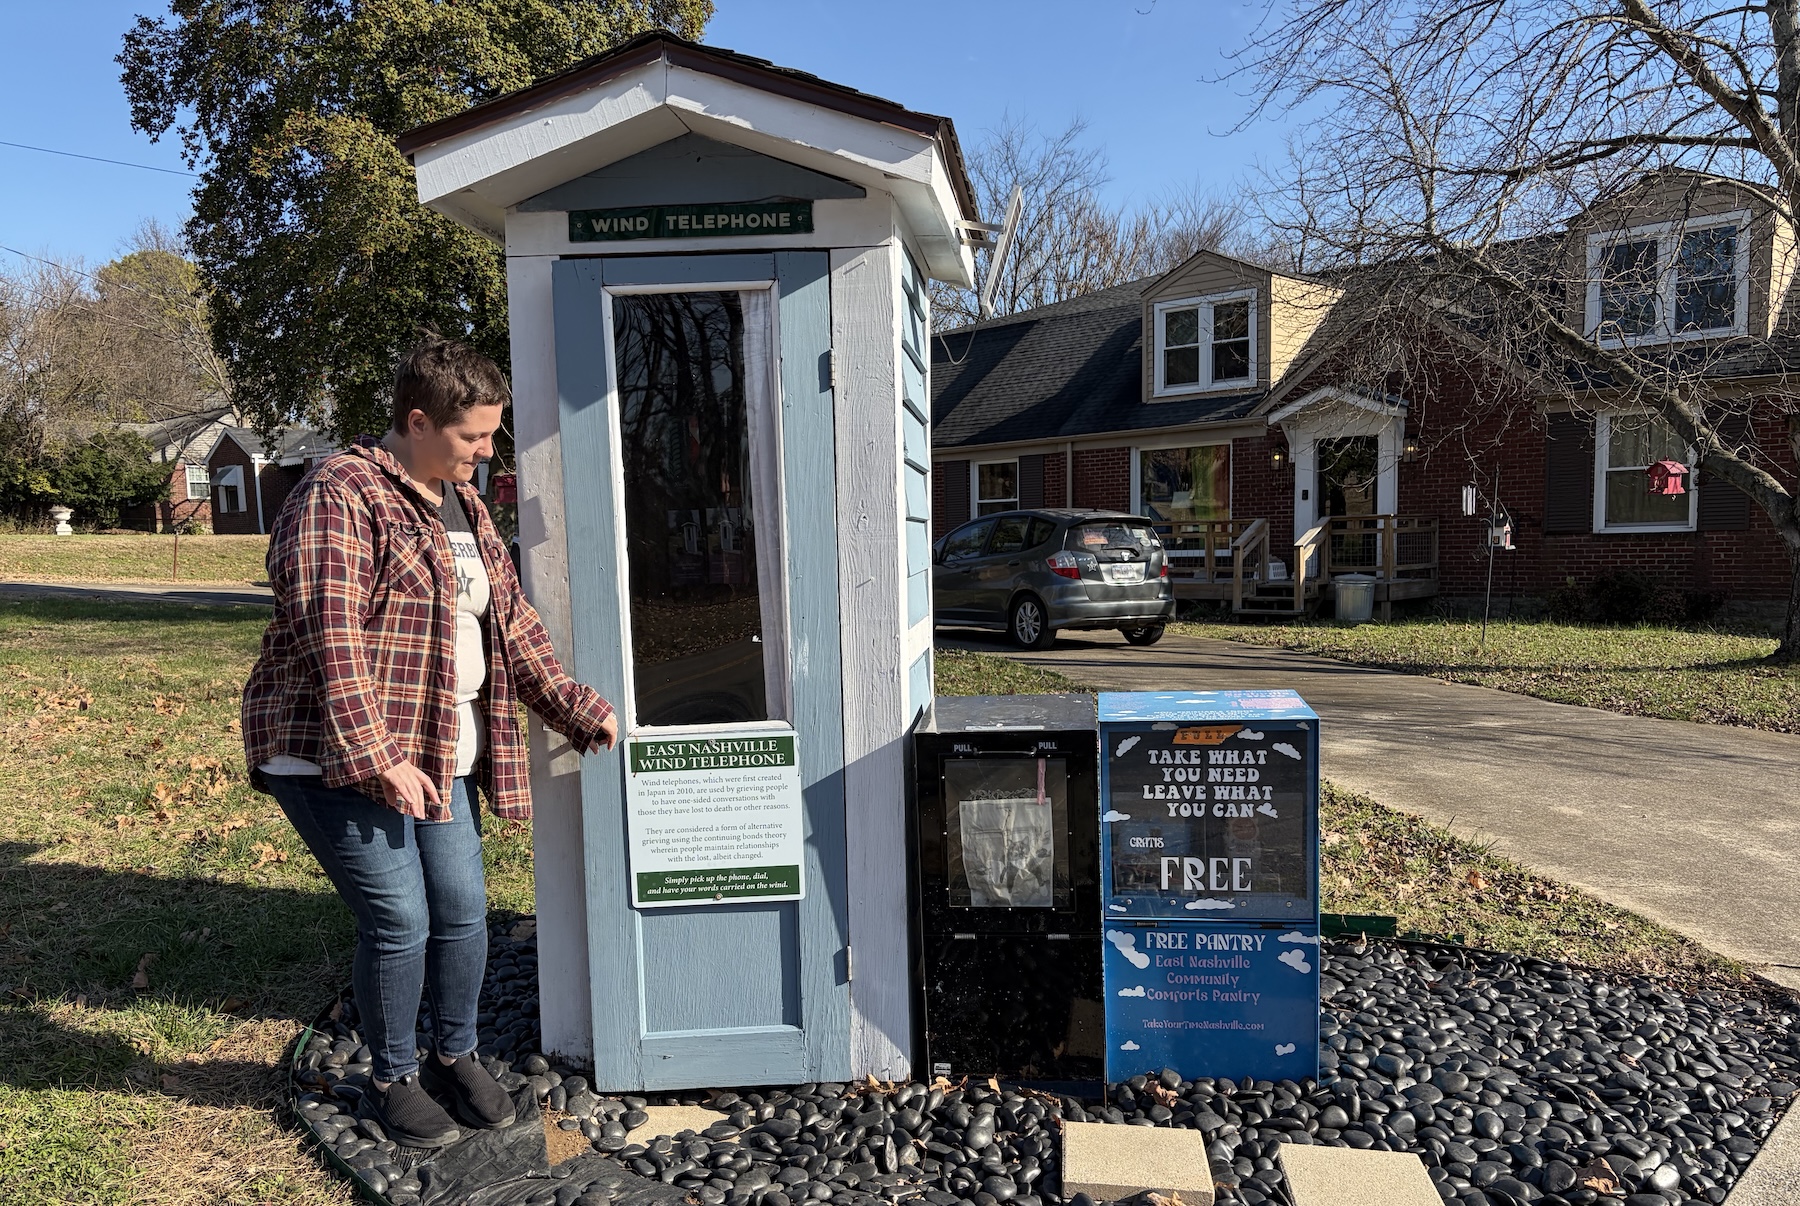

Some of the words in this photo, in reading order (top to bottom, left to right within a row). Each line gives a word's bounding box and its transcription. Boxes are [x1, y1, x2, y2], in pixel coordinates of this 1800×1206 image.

[591, 216, 649, 232] WIND
[666, 213, 791, 230] TELEPHONE
[1180, 730, 1224, 740] FULL
[646, 744, 686, 756] EAST
[689, 740, 778, 754] NASHVILLE
[639, 758, 686, 770] WIND
[689, 753, 786, 768] TELEPHONE
[1148, 750, 1200, 764] TAKE
[1208, 750, 1267, 764] WHAT
[662, 778, 701, 786] telephones,
[1162, 768, 1200, 782] YOU
[1208, 768, 1260, 782] NEED
[736, 785, 764, 794] grieving
[766, 783, 788, 792] people
[1142, 785, 1206, 800] LEAVE
[1214, 786, 1273, 800] WHAT
[678, 796, 711, 804] one-sided
[1166, 803, 1205, 817] YOU
[1212, 803, 1254, 817] CAN
[642, 838, 670, 846] grieving
[1129, 837, 1164, 848] GRATIS
[680, 845, 702, 854] people
[733, 852, 763, 860] changed.
[665, 876, 689, 885] Simply
[690, 875, 704, 884] pick
[728, 874, 751, 882] phone,
[1160, 856, 1252, 891] FREE
[1146, 932, 1188, 950] FREE
[1195, 933, 1266, 951] PANTRY
[1156, 955, 1184, 968] East
[1189, 956, 1250, 969] Nashville
[1166, 972, 1240, 988] Community
[1147, 989, 1208, 1002] Comforts
[1213, 990, 1260, 1005] Pantry
